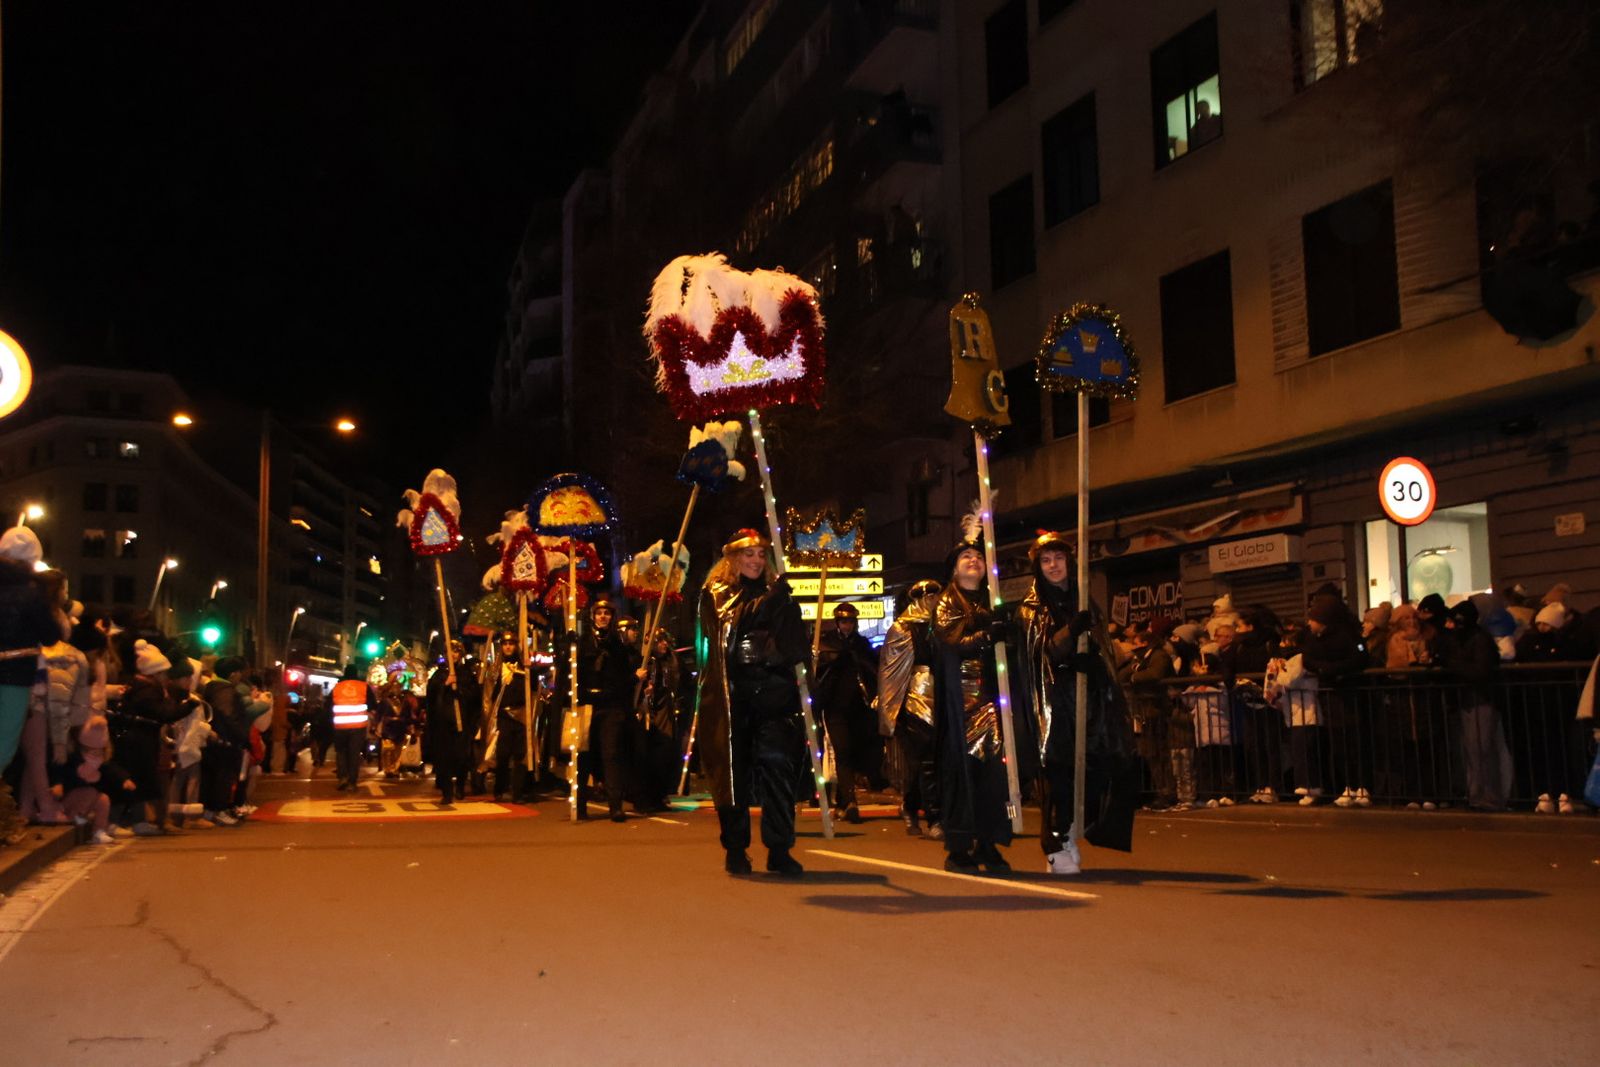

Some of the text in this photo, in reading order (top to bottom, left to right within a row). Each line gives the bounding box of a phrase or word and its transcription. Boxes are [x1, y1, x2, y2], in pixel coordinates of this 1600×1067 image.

[957, 318, 992, 361] R
[986, 369, 1009, 413] C
[1392, 480, 1423, 502] 30
[1218, 542, 1275, 560] El Globo
[1129, 581, 1183, 609] COMIDA
[331, 801, 458, 814] 30
